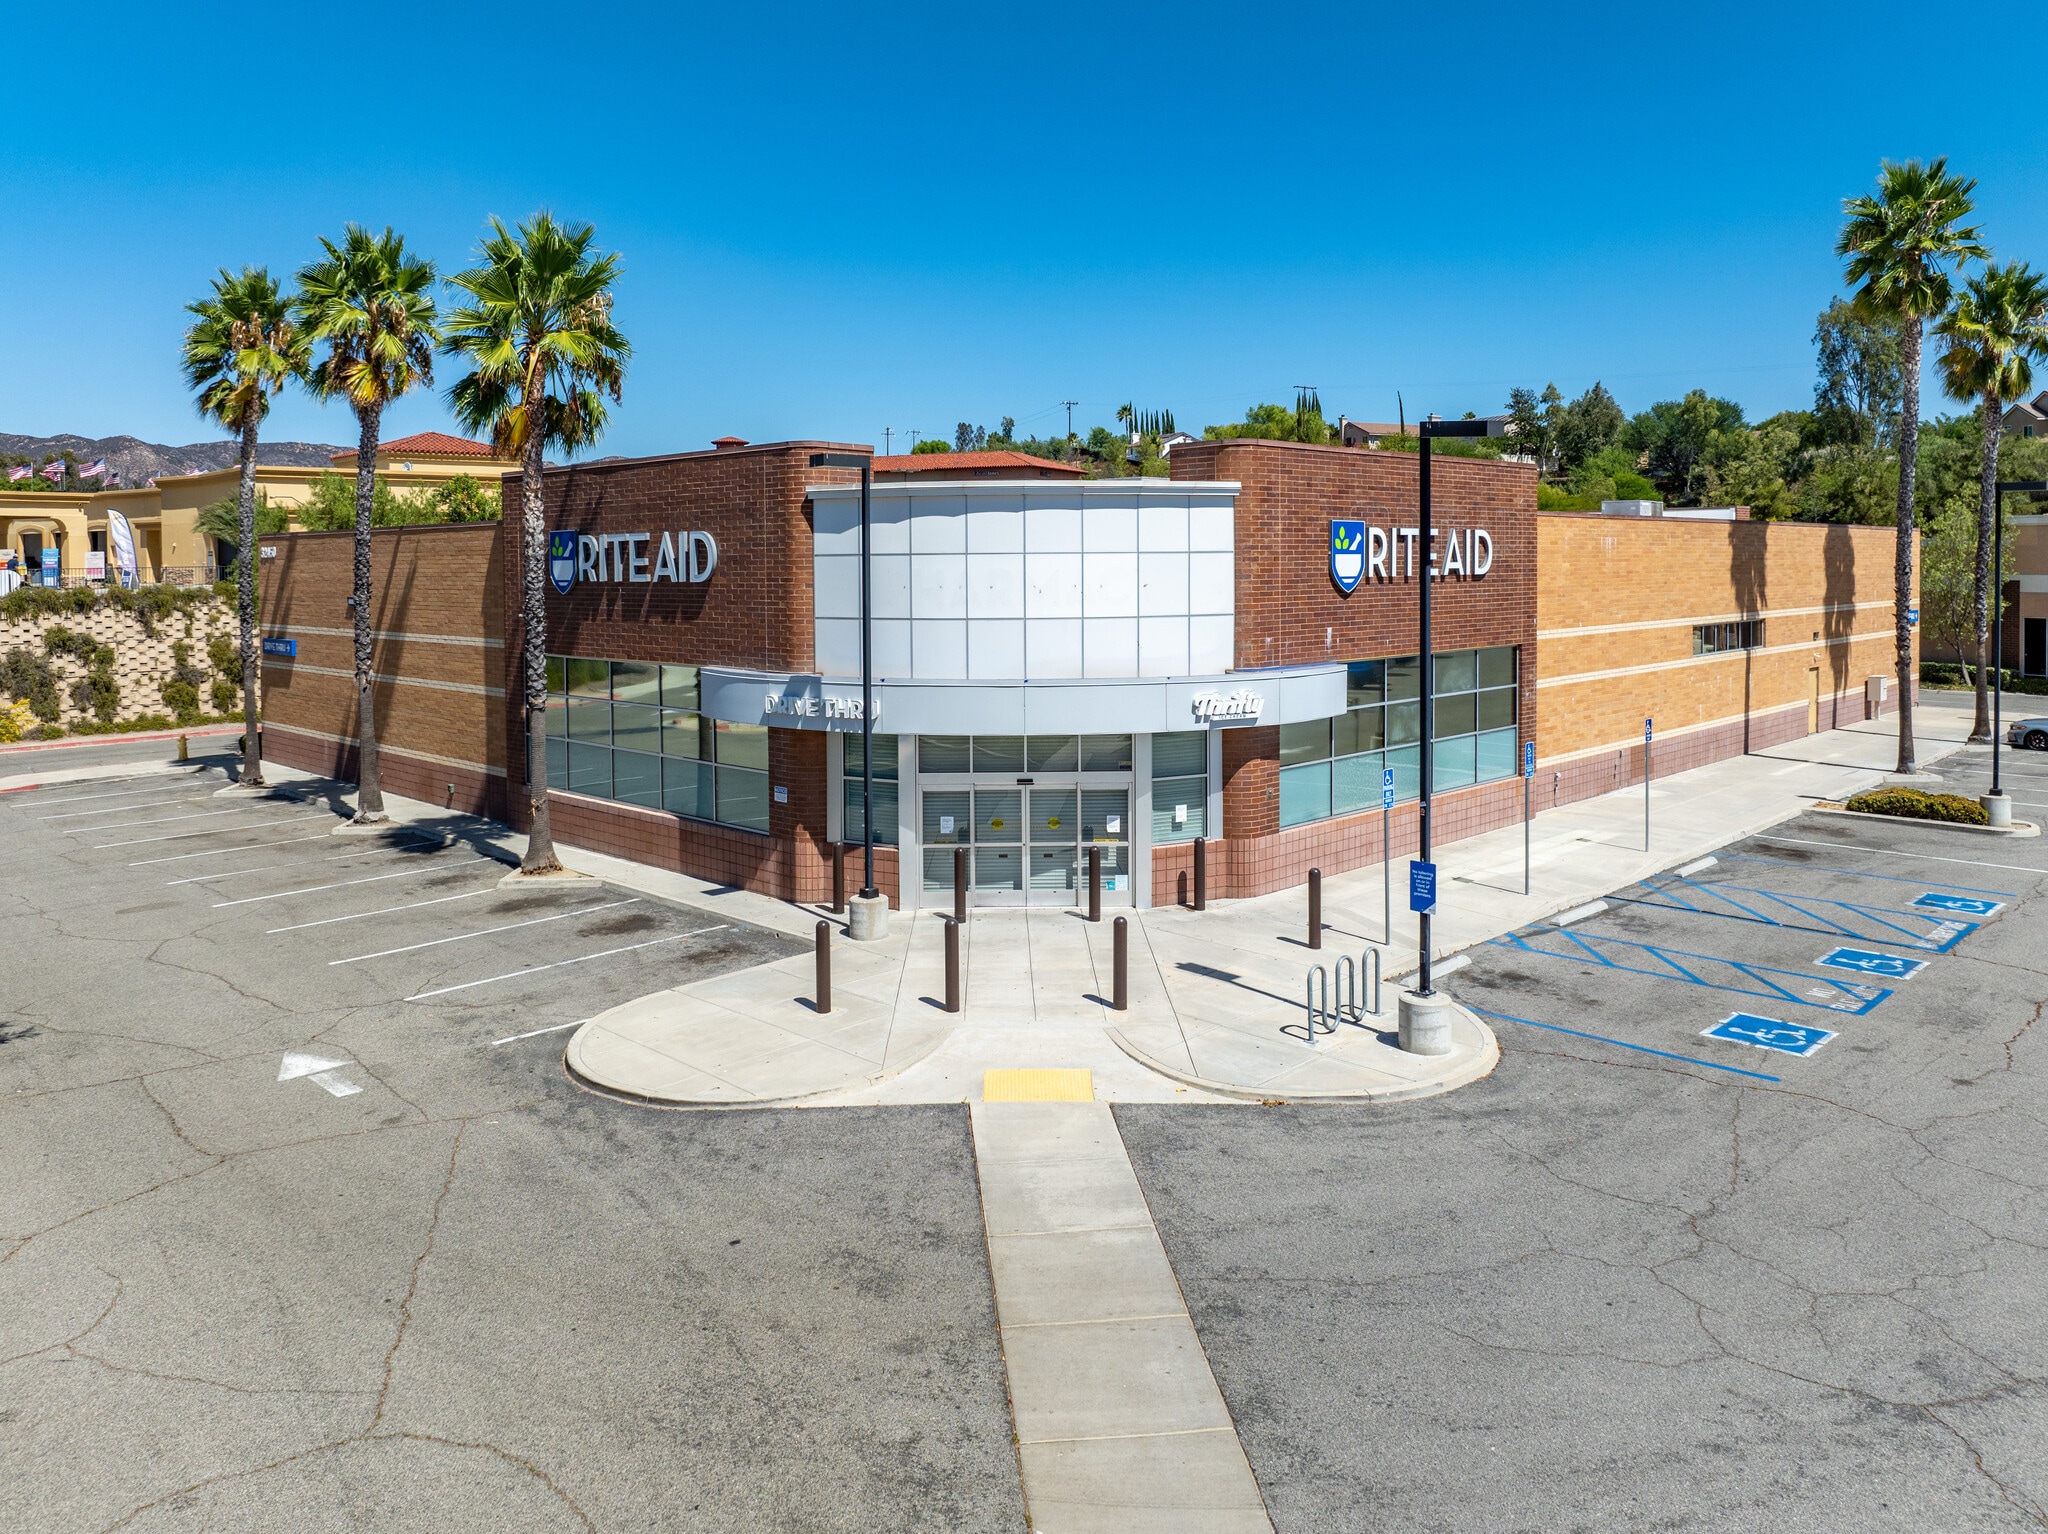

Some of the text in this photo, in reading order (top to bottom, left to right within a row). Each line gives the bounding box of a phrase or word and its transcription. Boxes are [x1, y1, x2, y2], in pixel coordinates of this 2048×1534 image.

[578, 531, 719, 583] RITE AID
[1441, 528, 1493, 576] AID
[765, 695, 820, 717] DRIVE
[1194, 689, 1264, 719] Thrifty
